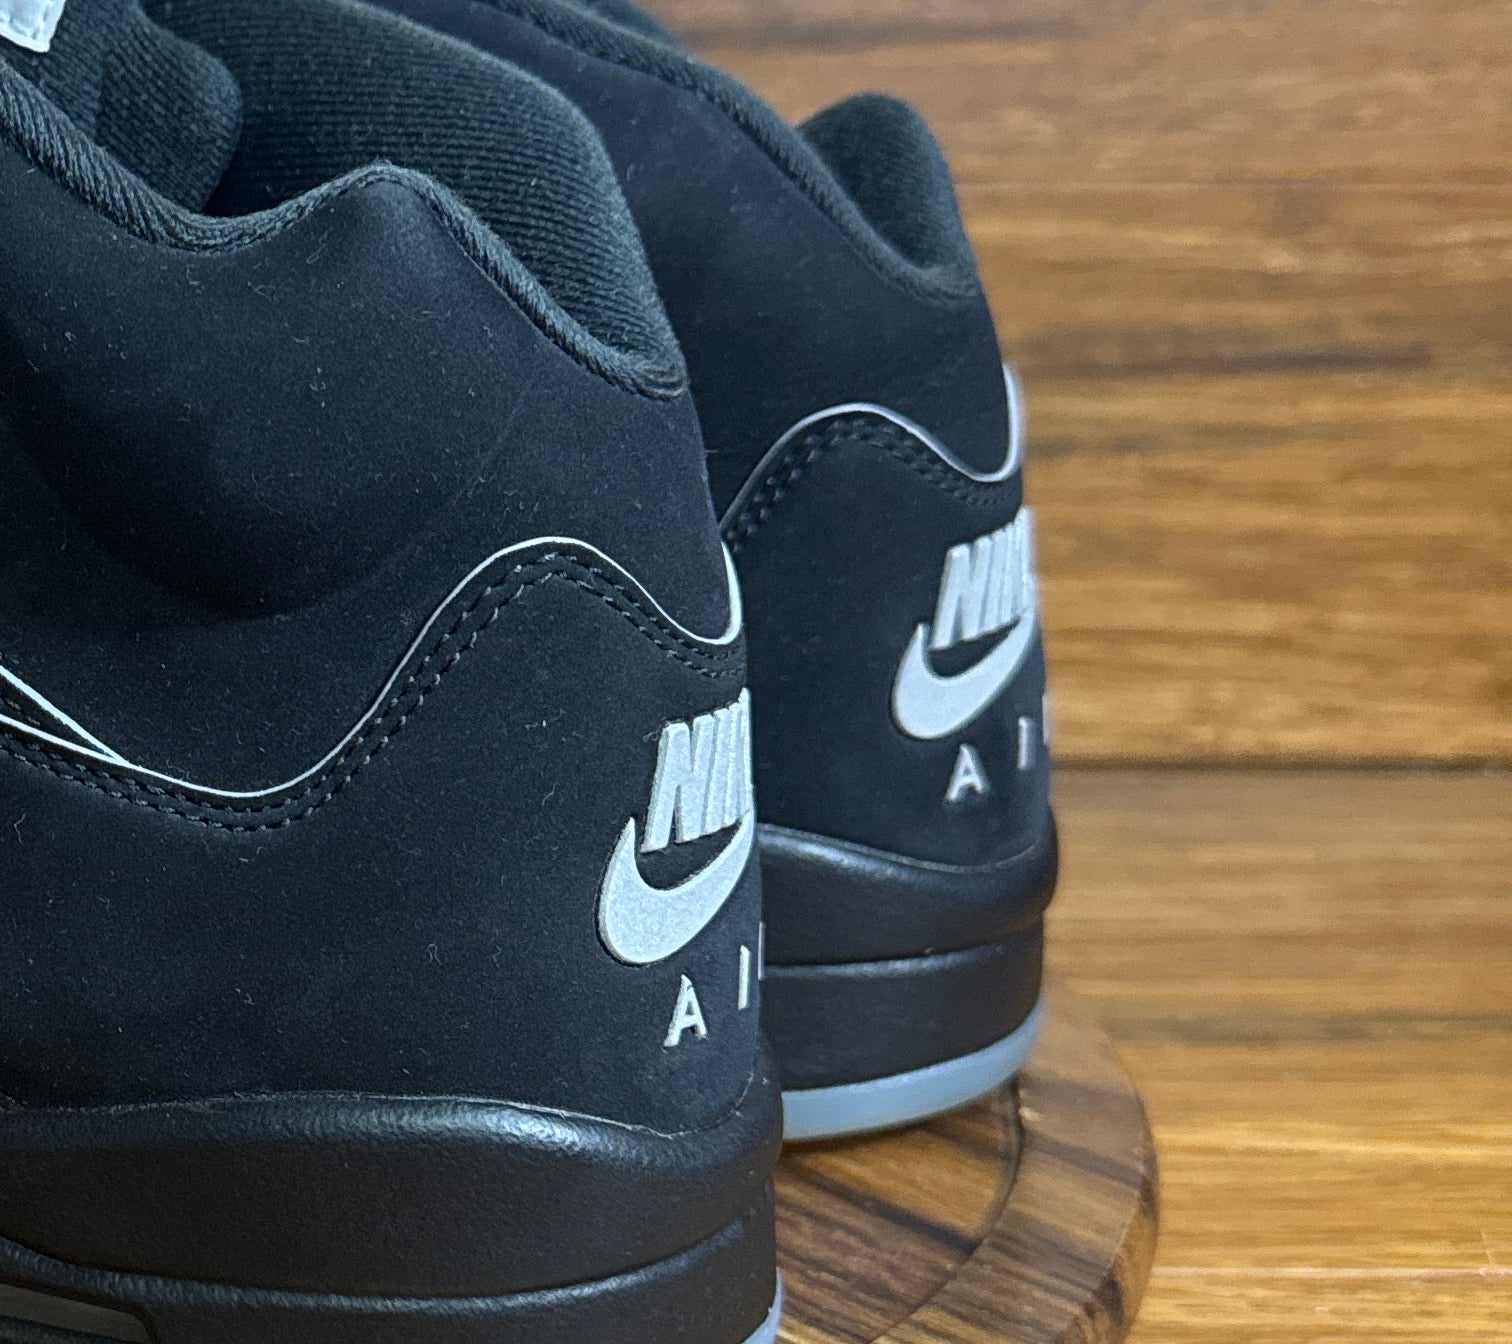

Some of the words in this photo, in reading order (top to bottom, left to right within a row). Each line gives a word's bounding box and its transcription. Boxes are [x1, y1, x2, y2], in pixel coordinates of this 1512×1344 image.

[640, 687, 753, 854] NIK
[945, 693, 1050, 803] AI
[662, 921, 765, 1049] AI
